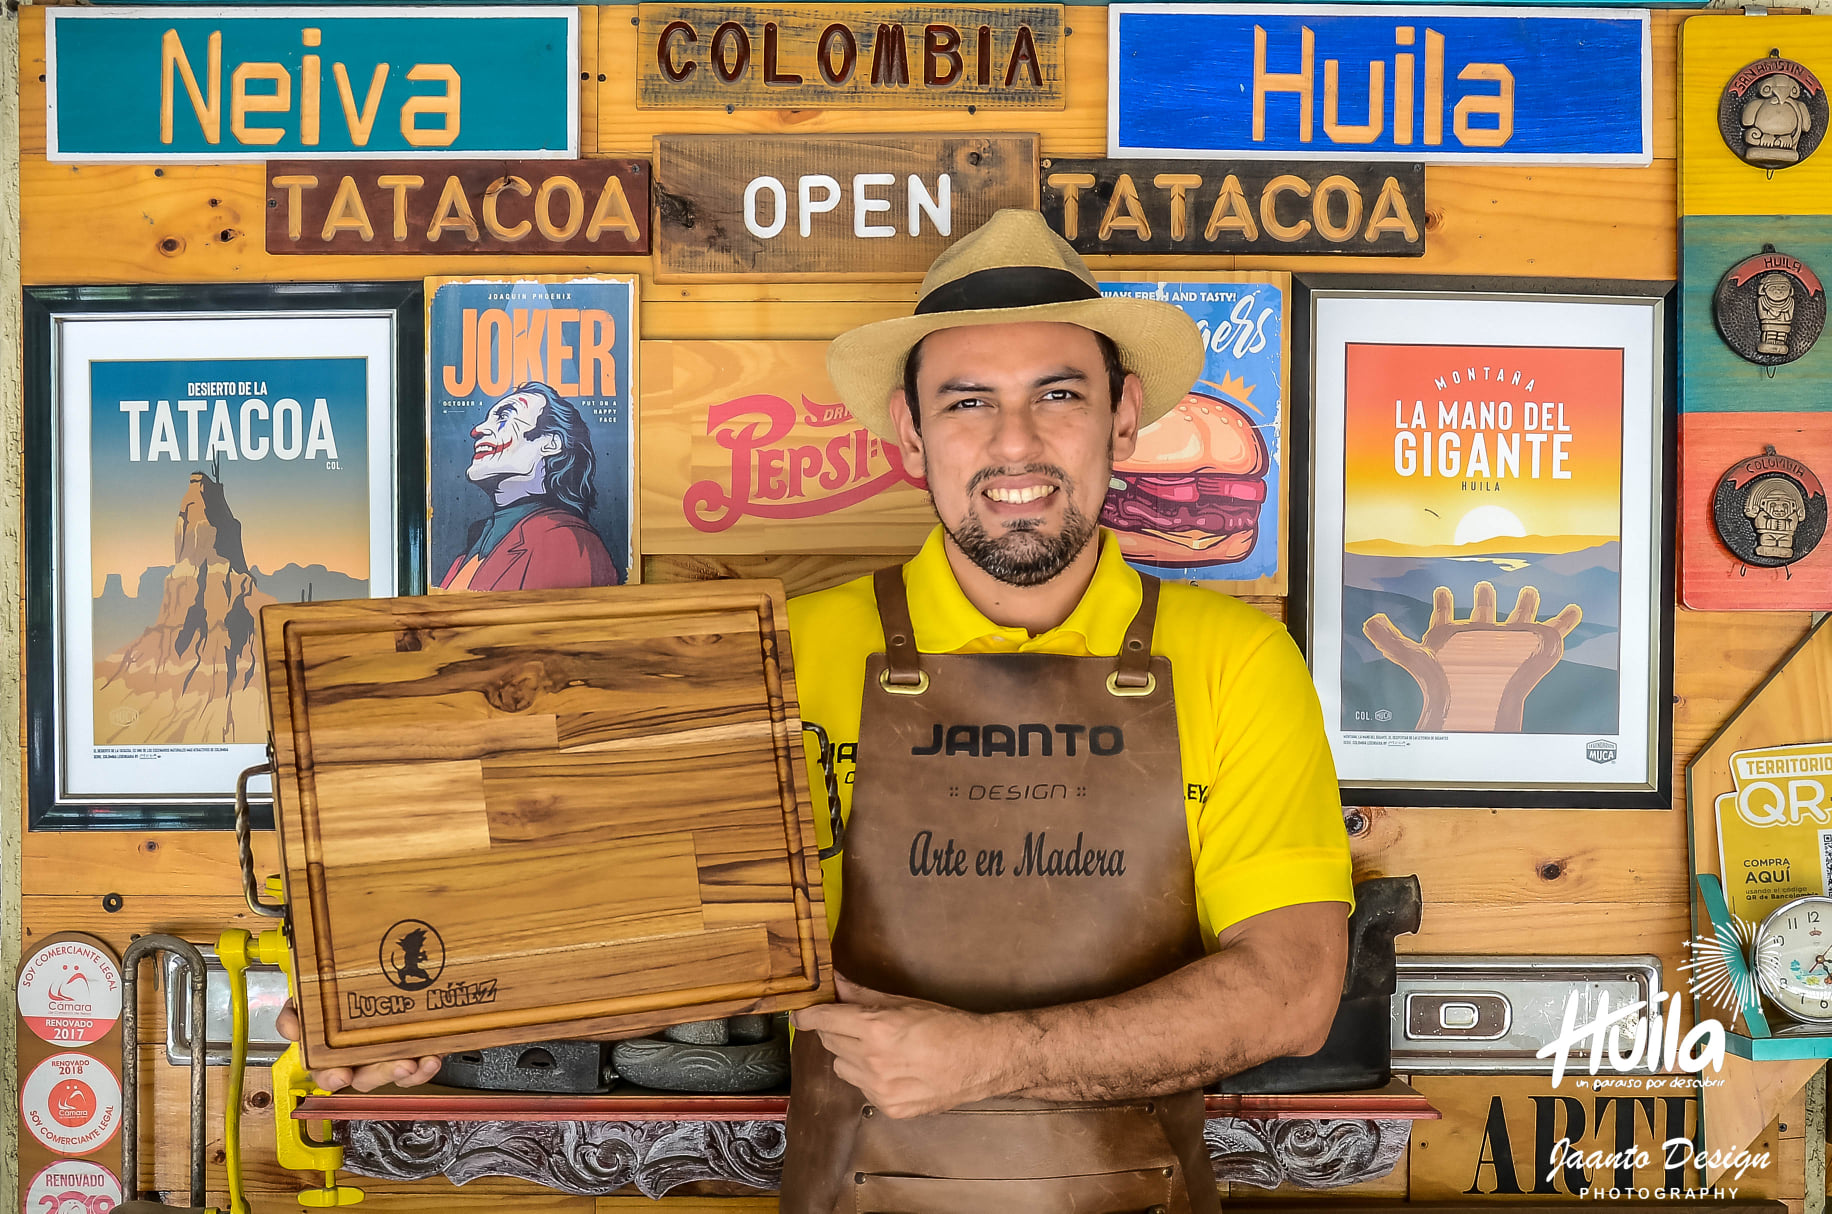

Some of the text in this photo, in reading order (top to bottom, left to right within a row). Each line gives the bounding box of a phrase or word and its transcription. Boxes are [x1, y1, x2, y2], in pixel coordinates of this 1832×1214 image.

[657, 21, 1044, 88] COLOMBIA
[160, 27, 461, 147] Neiva
[1252, 24, 1515, 148] Huila
[1735, 68, 1757, 90] SAN
[272, 175, 641, 243] TATACOA
[743, 173, 952, 239] OPEN
[1047, 173, 1420, 243] TATACOA
[1764, 256, 1802, 272] HUILA
[1171, 292, 1197, 302] AND
[1200, 292, 1237, 302] TASTY!
[443, 308, 616, 397] JOKER
[1434, 366, 1535, 392] MONTAÑA
[187, 381, 267, 396] DESIERTO DE LA
[1395, 400, 1571, 431] LA MANO DEL
[119, 398, 338, 462] TATACOA
[1394, 431, 1573, 480] GIGANTE
[326, 461, 343, 470] COL.
[1461, 481, 1500, 491] HUILA
[1355, 710, 1373, 720] COL.
[911, 723, 1125, 757] JAANTO
[1590, 750, 1614, 760] MUCA
[968, 784, 1068, 800] DESIGN
[1739, 780, 1827, 824] QR
[909, 830, 1127, 878] Arte en Madera
[1743, 858, 1790, 868] COMPRA
[1745, 866, 1790, 884] AQUÍ
[1788, 917, 1798, 930] 11
[1807, 911, 1820, 923] 12
[23, 945, 118, 991] SOY COMERCIANTE LEGAL
[48, 1002, 92, 1012] Cámara
[45, 1019, 94, 1028] RENOVADO
[54, 1028, 85, 1040] 2017
[51, 1059, 90, 1067] RENOVADO
[59, 1066, 83, 1075] 2018
[29, 1105, 114, 1145] SOY COMERCIANTE LEGAL
[46, 1174, 105, 1187] RENOVADO
